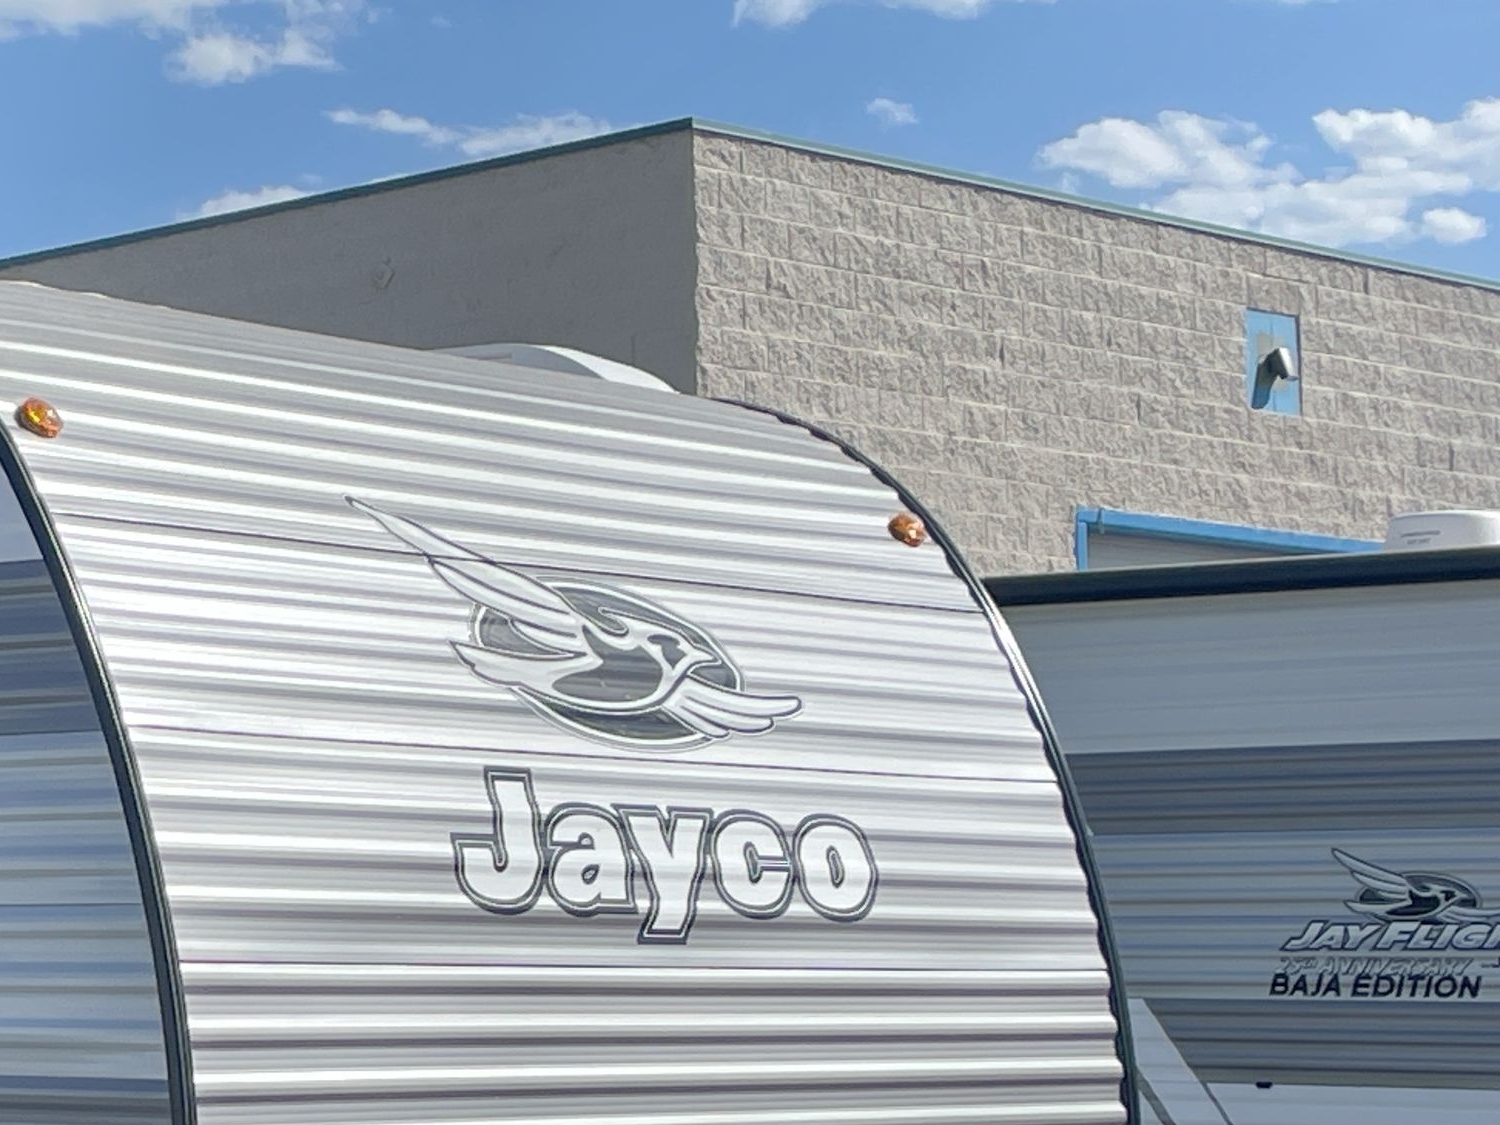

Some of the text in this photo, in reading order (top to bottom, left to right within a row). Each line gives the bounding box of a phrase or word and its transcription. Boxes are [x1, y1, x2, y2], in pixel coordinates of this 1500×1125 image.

[450, 765, 878, 945] Jayco
[1280, 920, 1385, 951] JAY
[1317, 956, 1474, 977] ANNIVERSARY
[1269, 972, 1482, 999] BAJA EDITION
